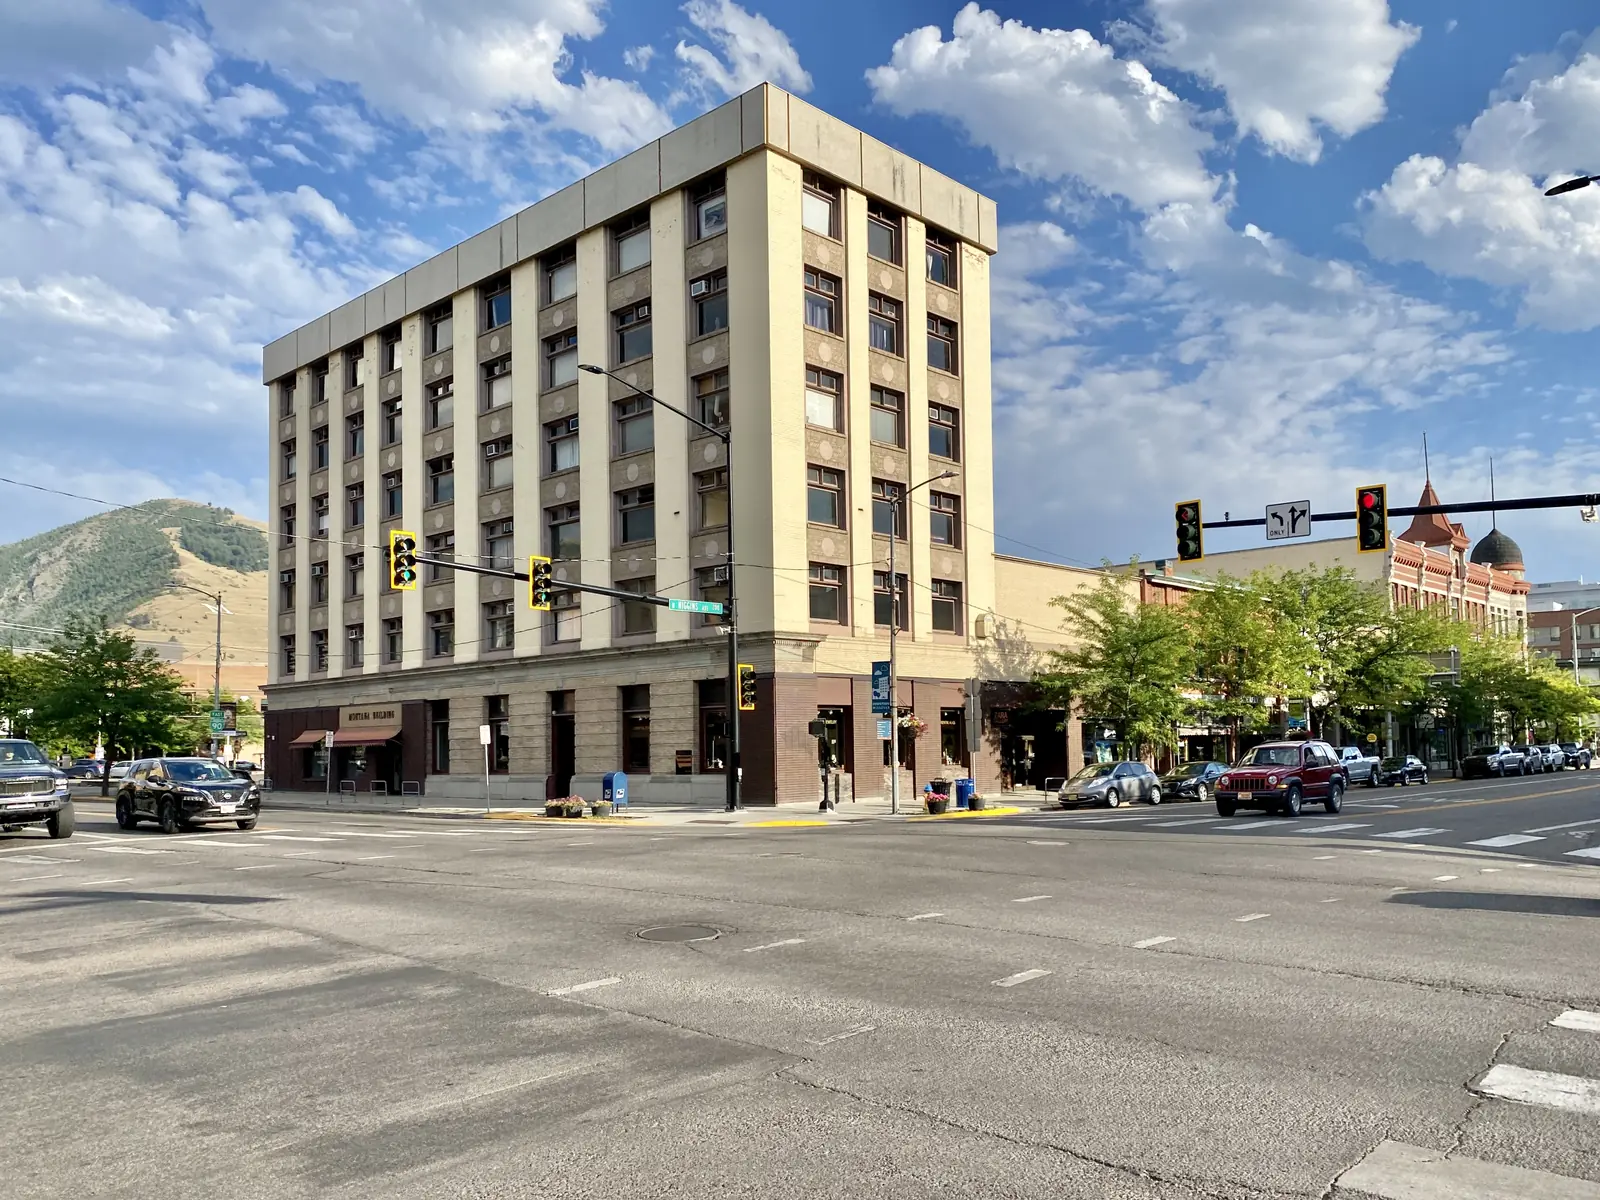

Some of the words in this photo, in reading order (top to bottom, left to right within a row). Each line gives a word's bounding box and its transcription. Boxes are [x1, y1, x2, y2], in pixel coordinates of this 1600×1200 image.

[678, 600, 699, 611] HIGGINS
[348, 712, 370, 721] MONTANA
[372, 710, 395, 719] BUILDING
[212, 722, 222, 730] 90
